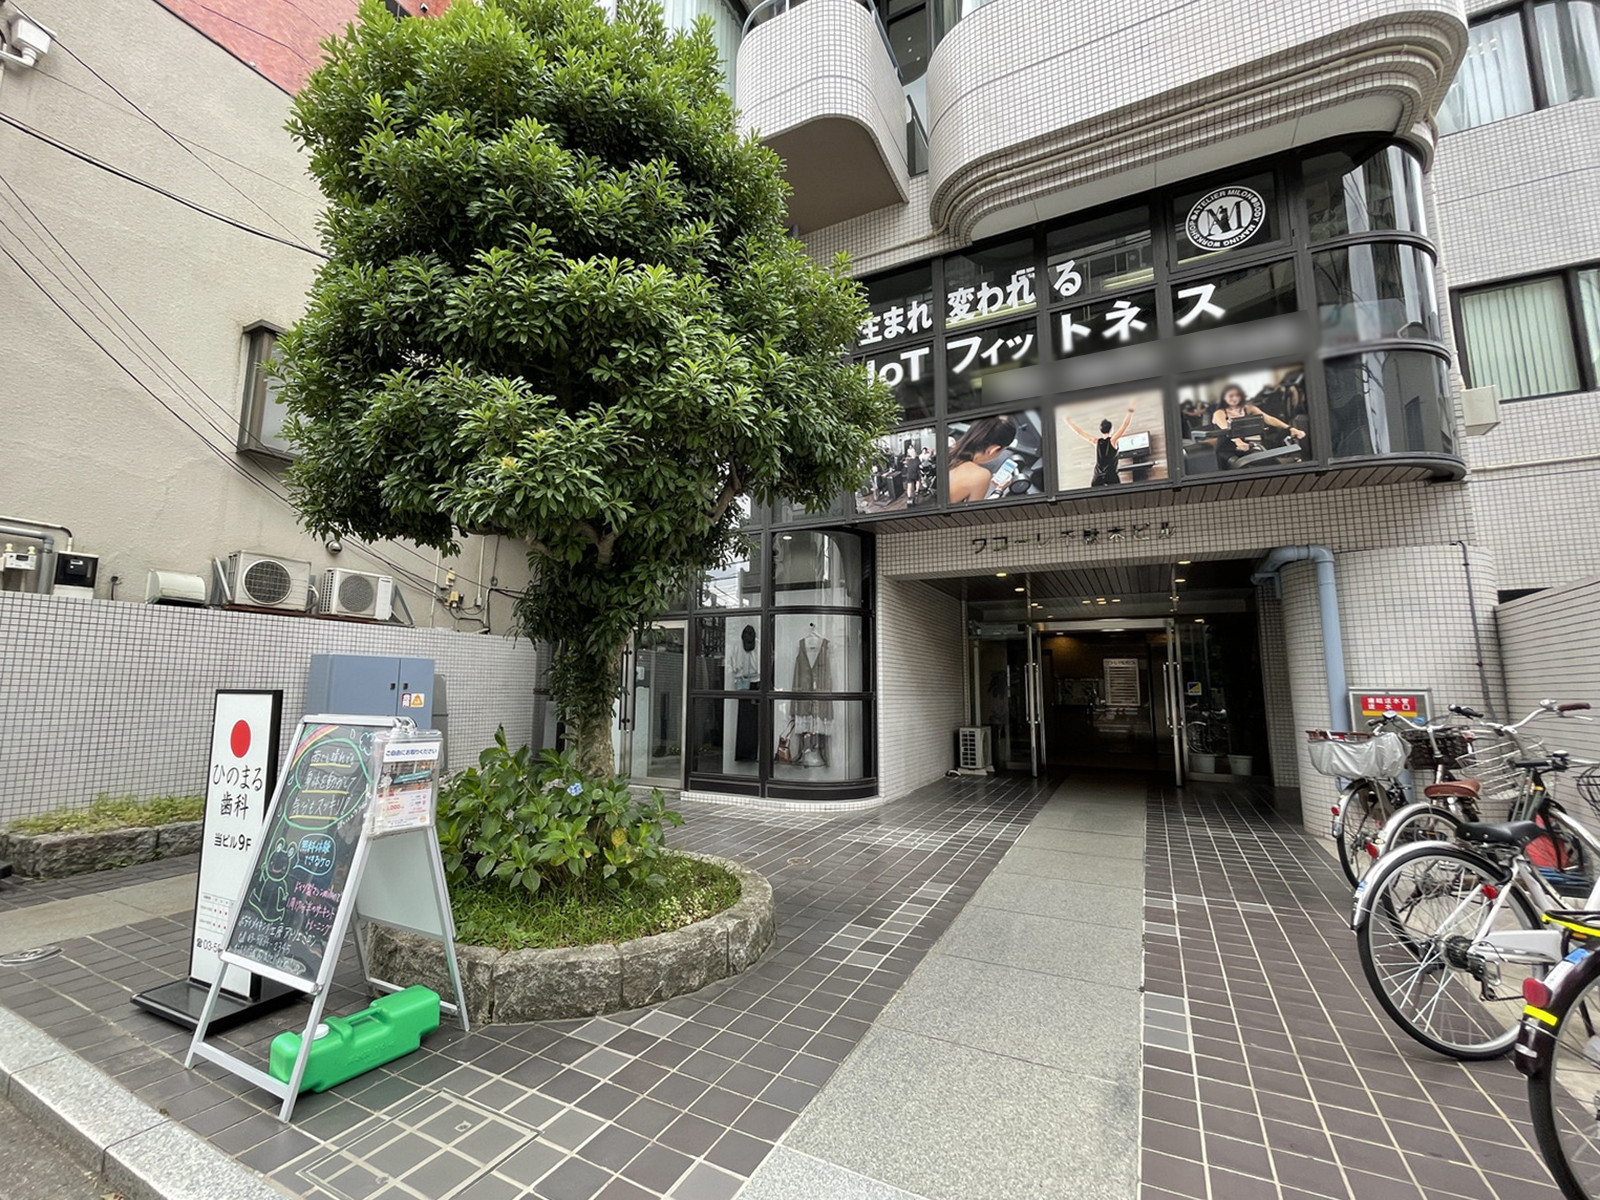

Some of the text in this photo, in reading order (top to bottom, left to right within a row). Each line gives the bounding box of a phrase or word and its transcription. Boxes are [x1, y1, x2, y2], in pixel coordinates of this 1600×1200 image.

[1189, 189, 1262, 247] ATELIER MILON BODY MAKING WORKSHOP
[212, 763, 263, 792] ひのまる
[220, 791, 249, 820] 歯科
[213, 832, 252, 851] 当ビル9F
[300, 839, 331, 854] 無料体験
